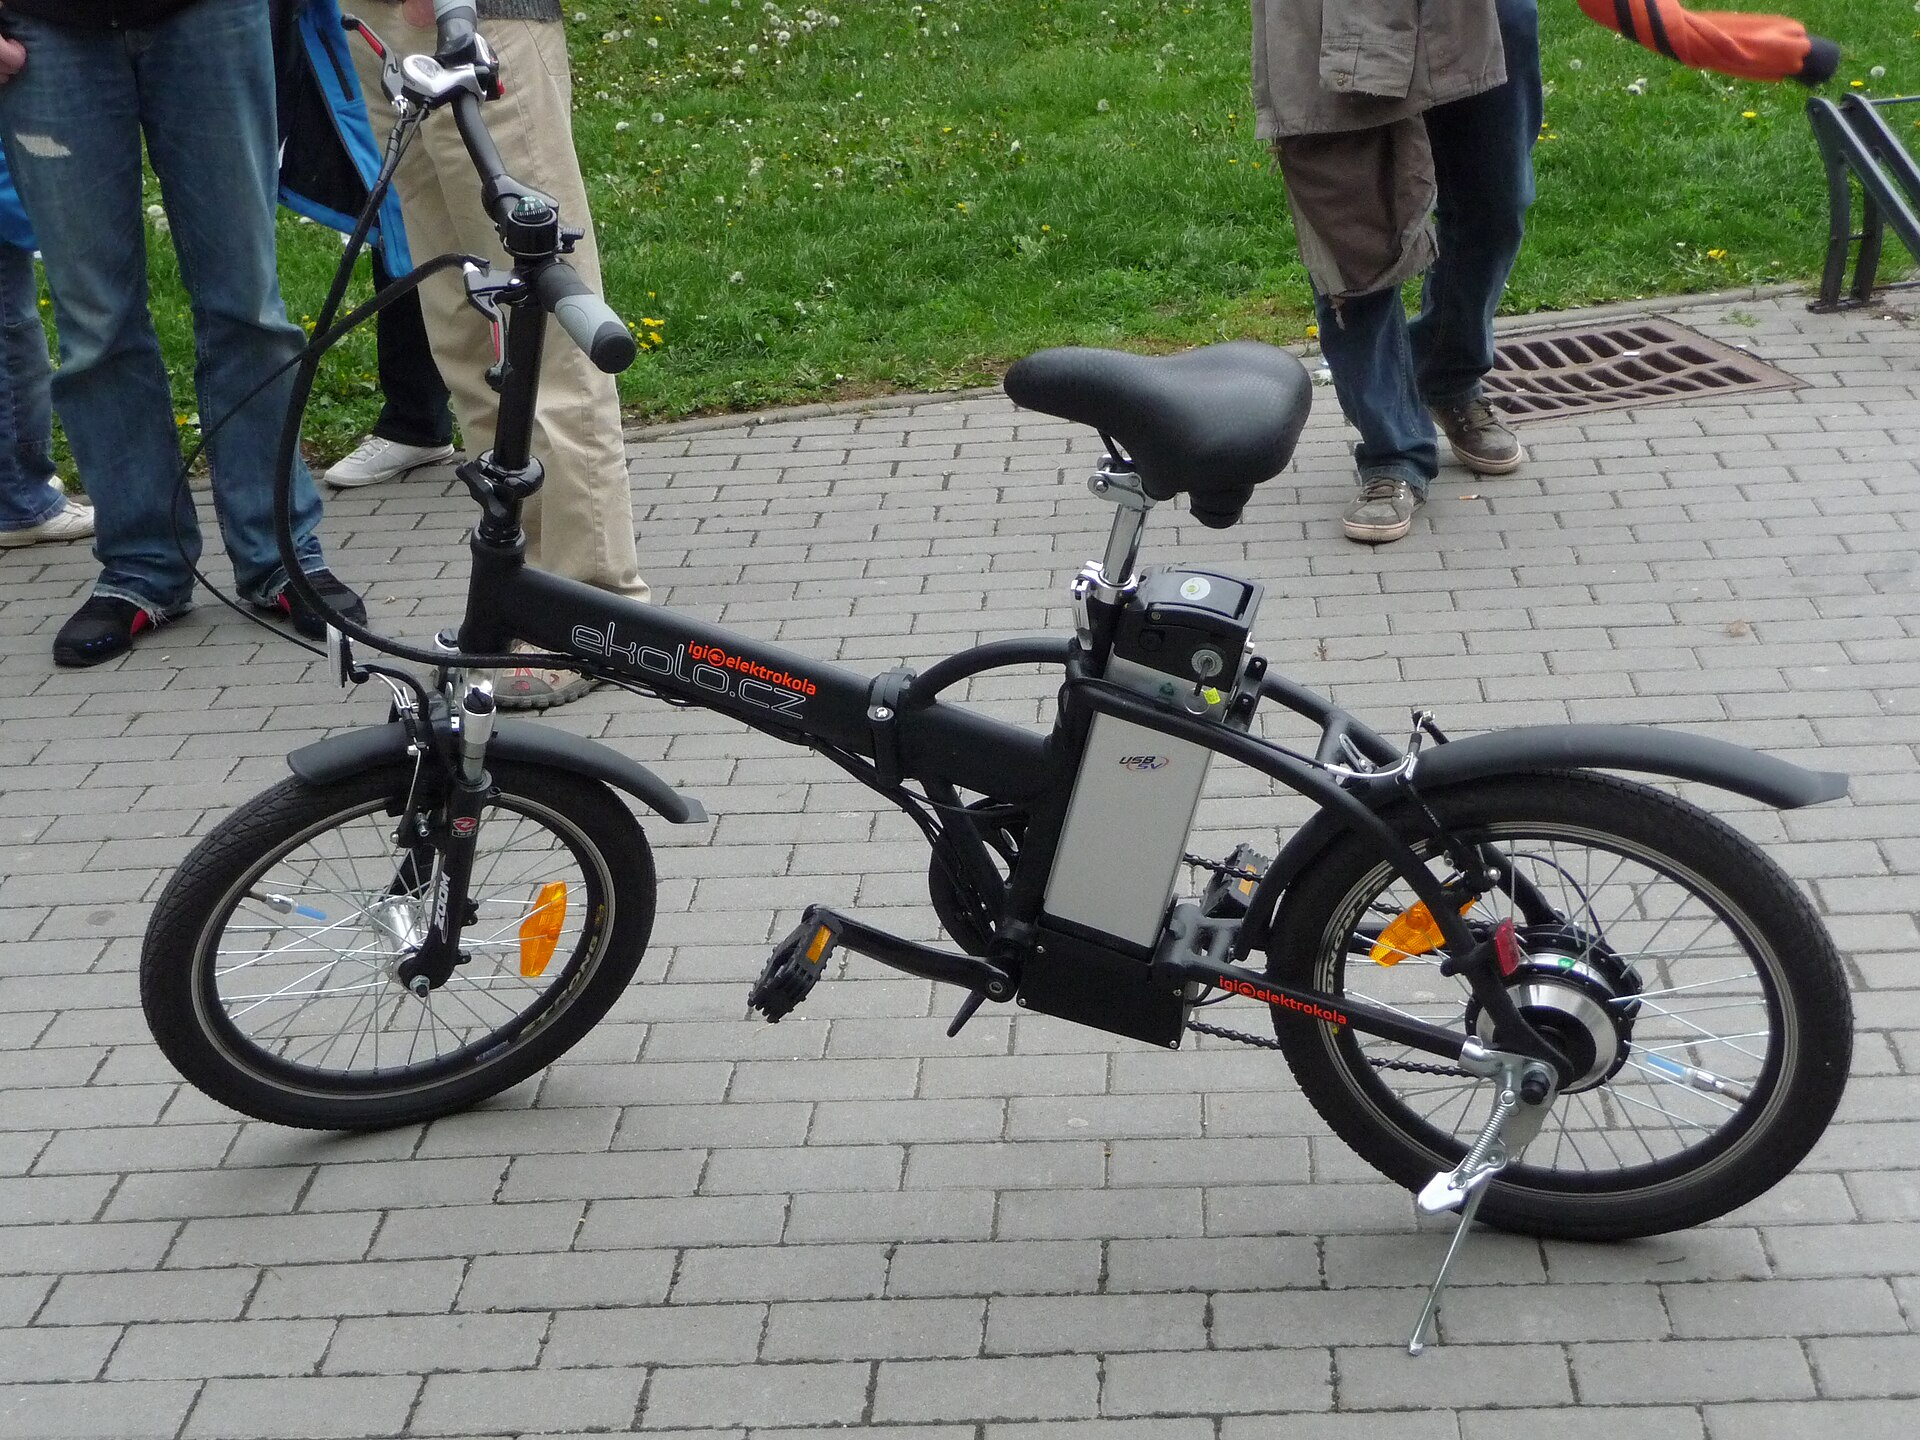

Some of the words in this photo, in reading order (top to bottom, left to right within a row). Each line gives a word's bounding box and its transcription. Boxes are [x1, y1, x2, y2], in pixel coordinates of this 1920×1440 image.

[571, 622, 806, 719] ekolo.cz
[1119, 756, 1156, 764] USB
[434, 871, 451, 930] ZOOM
